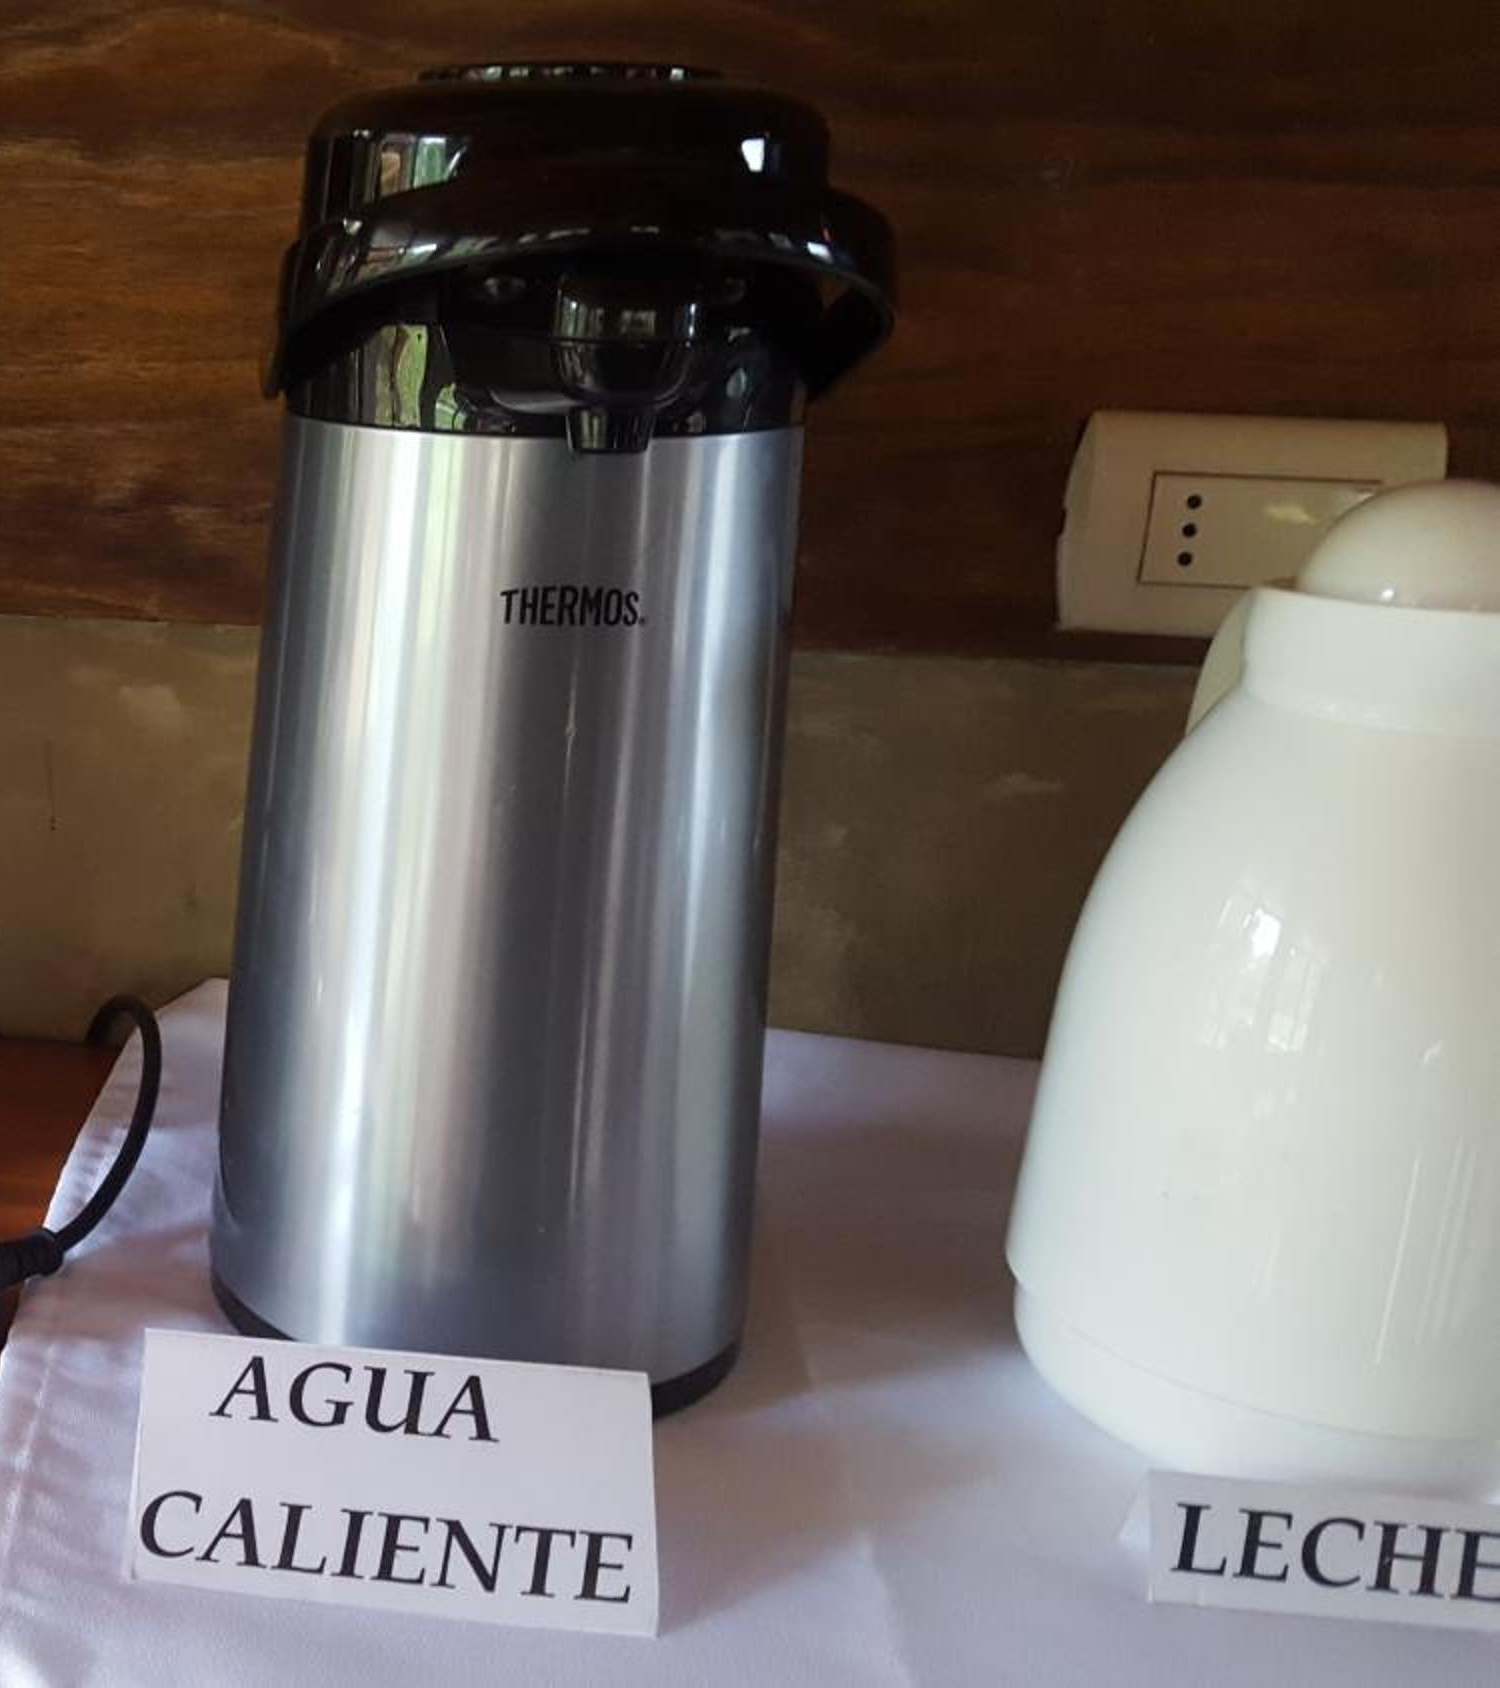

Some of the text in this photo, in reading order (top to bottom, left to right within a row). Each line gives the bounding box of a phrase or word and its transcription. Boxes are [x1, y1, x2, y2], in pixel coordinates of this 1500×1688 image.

[500, 585, 639, 626] THERMOS
[209, 1355, 499, 1442] AGUA
[139, 1490, 634, 1604] CALIENTE
